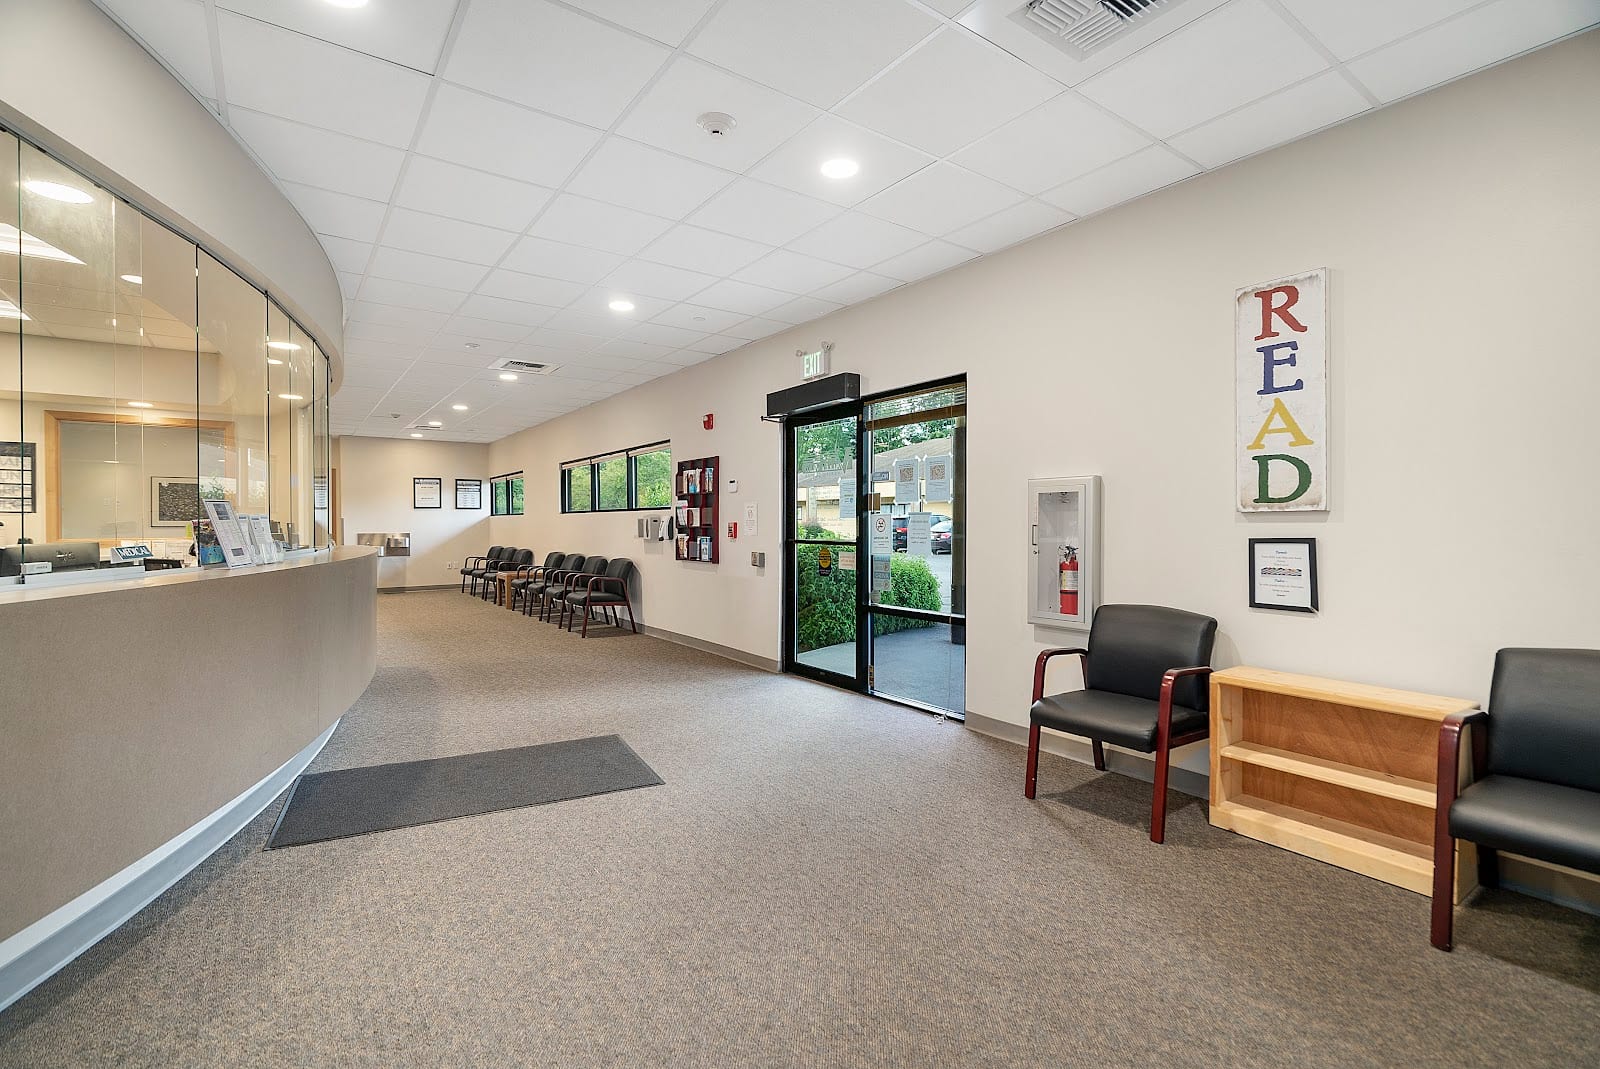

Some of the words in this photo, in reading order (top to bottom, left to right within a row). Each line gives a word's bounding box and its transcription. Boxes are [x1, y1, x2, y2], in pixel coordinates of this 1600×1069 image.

[803, 351, 822, 377] EXIT
[1247, 285, 1314, 504] READ
[118, 547, 150, 558] MEDICAL
